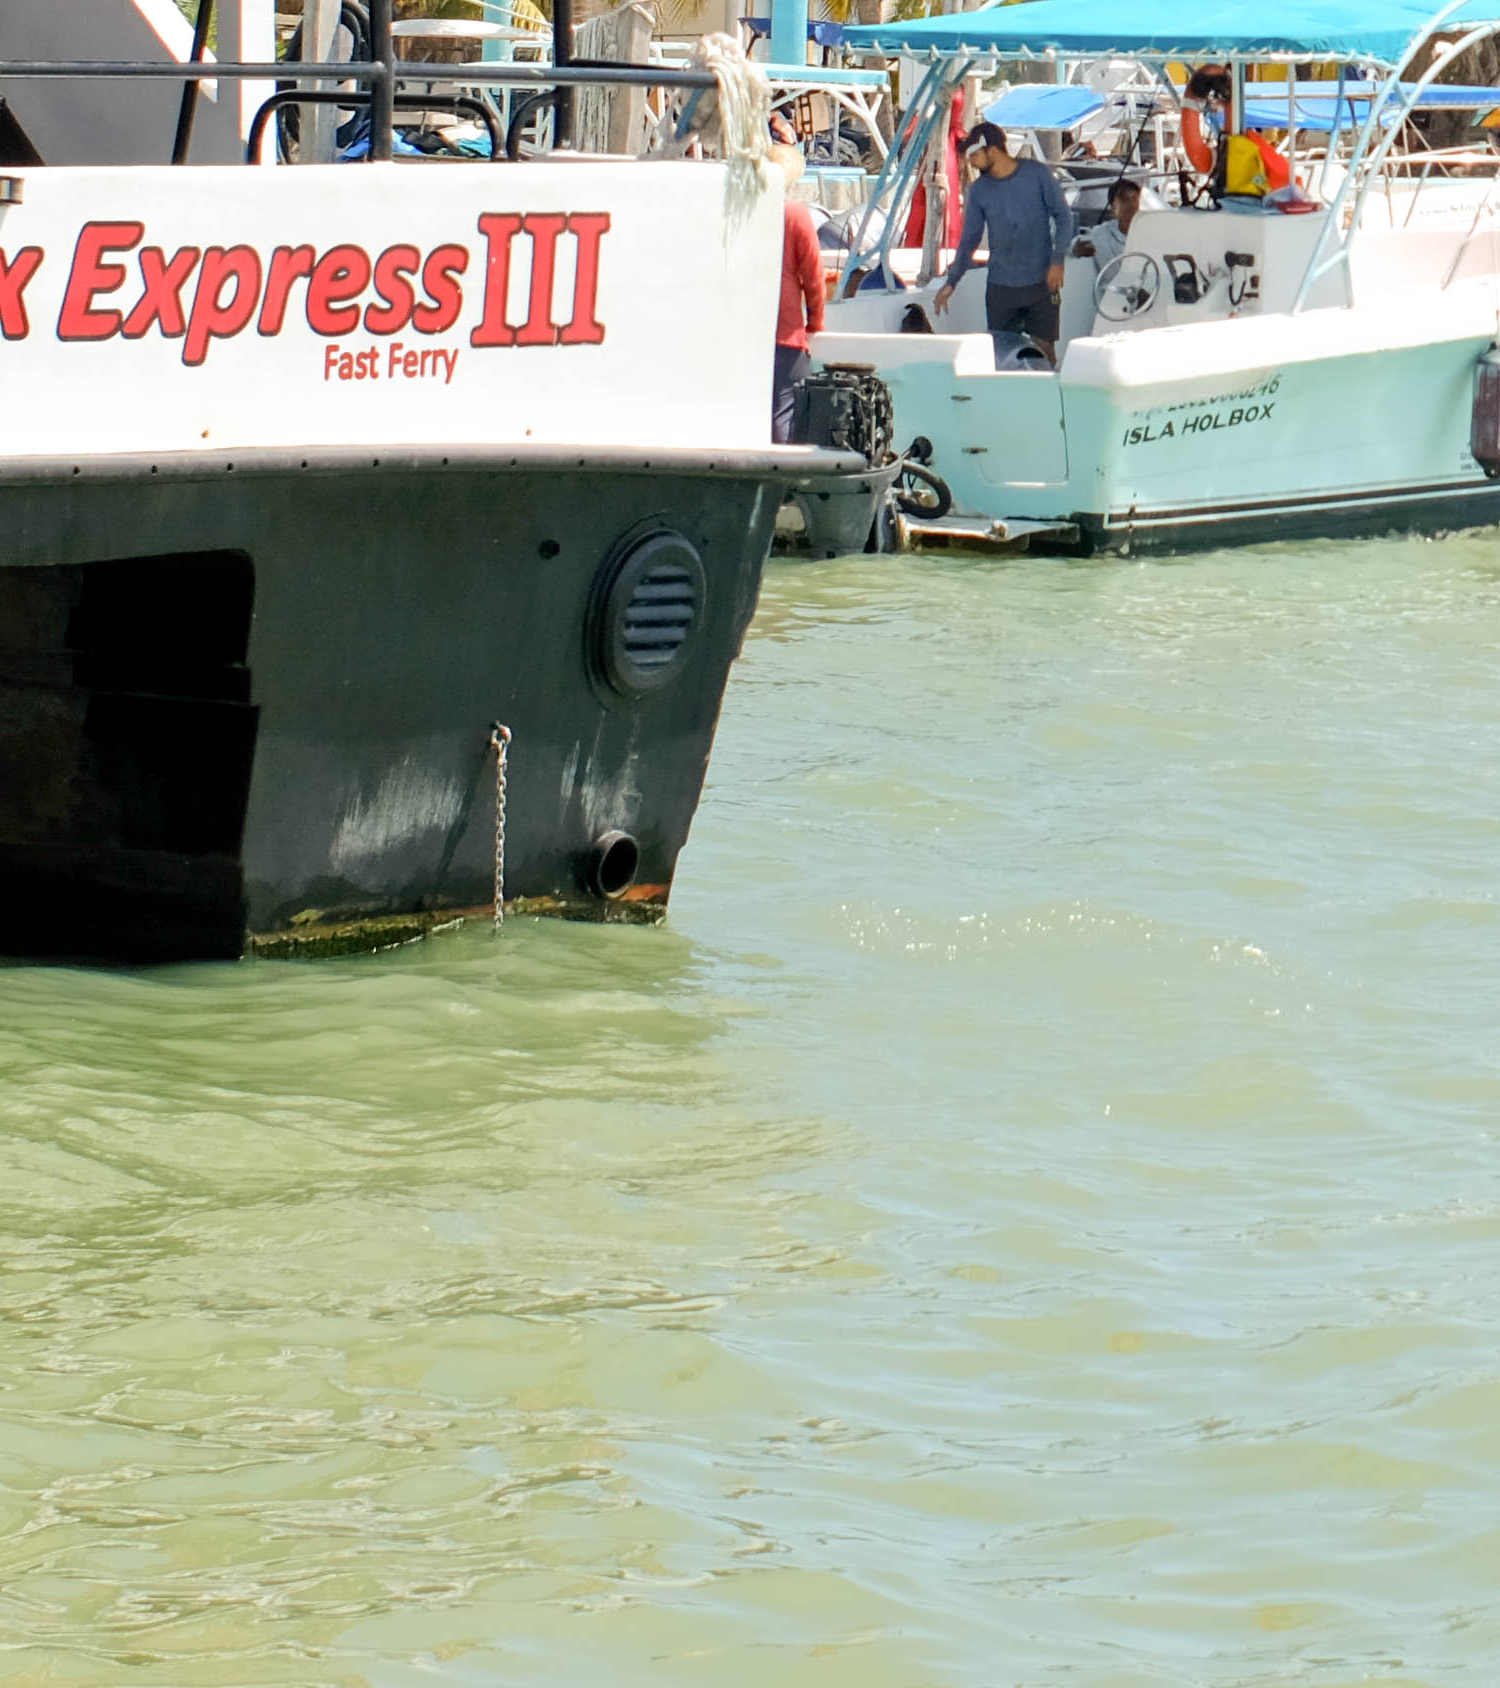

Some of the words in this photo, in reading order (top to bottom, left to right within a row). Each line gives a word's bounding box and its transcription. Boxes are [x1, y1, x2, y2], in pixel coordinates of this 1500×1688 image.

[55, 220, 470, 368] Express
[469, 211, 612, 350] III
[324, 344, 381, 381] Fast
[387, 342, 460, 385] Ferry
[1122, 420, 1176, 447] ISLA
[1180, 401, 1276, 436] HOLBOX
